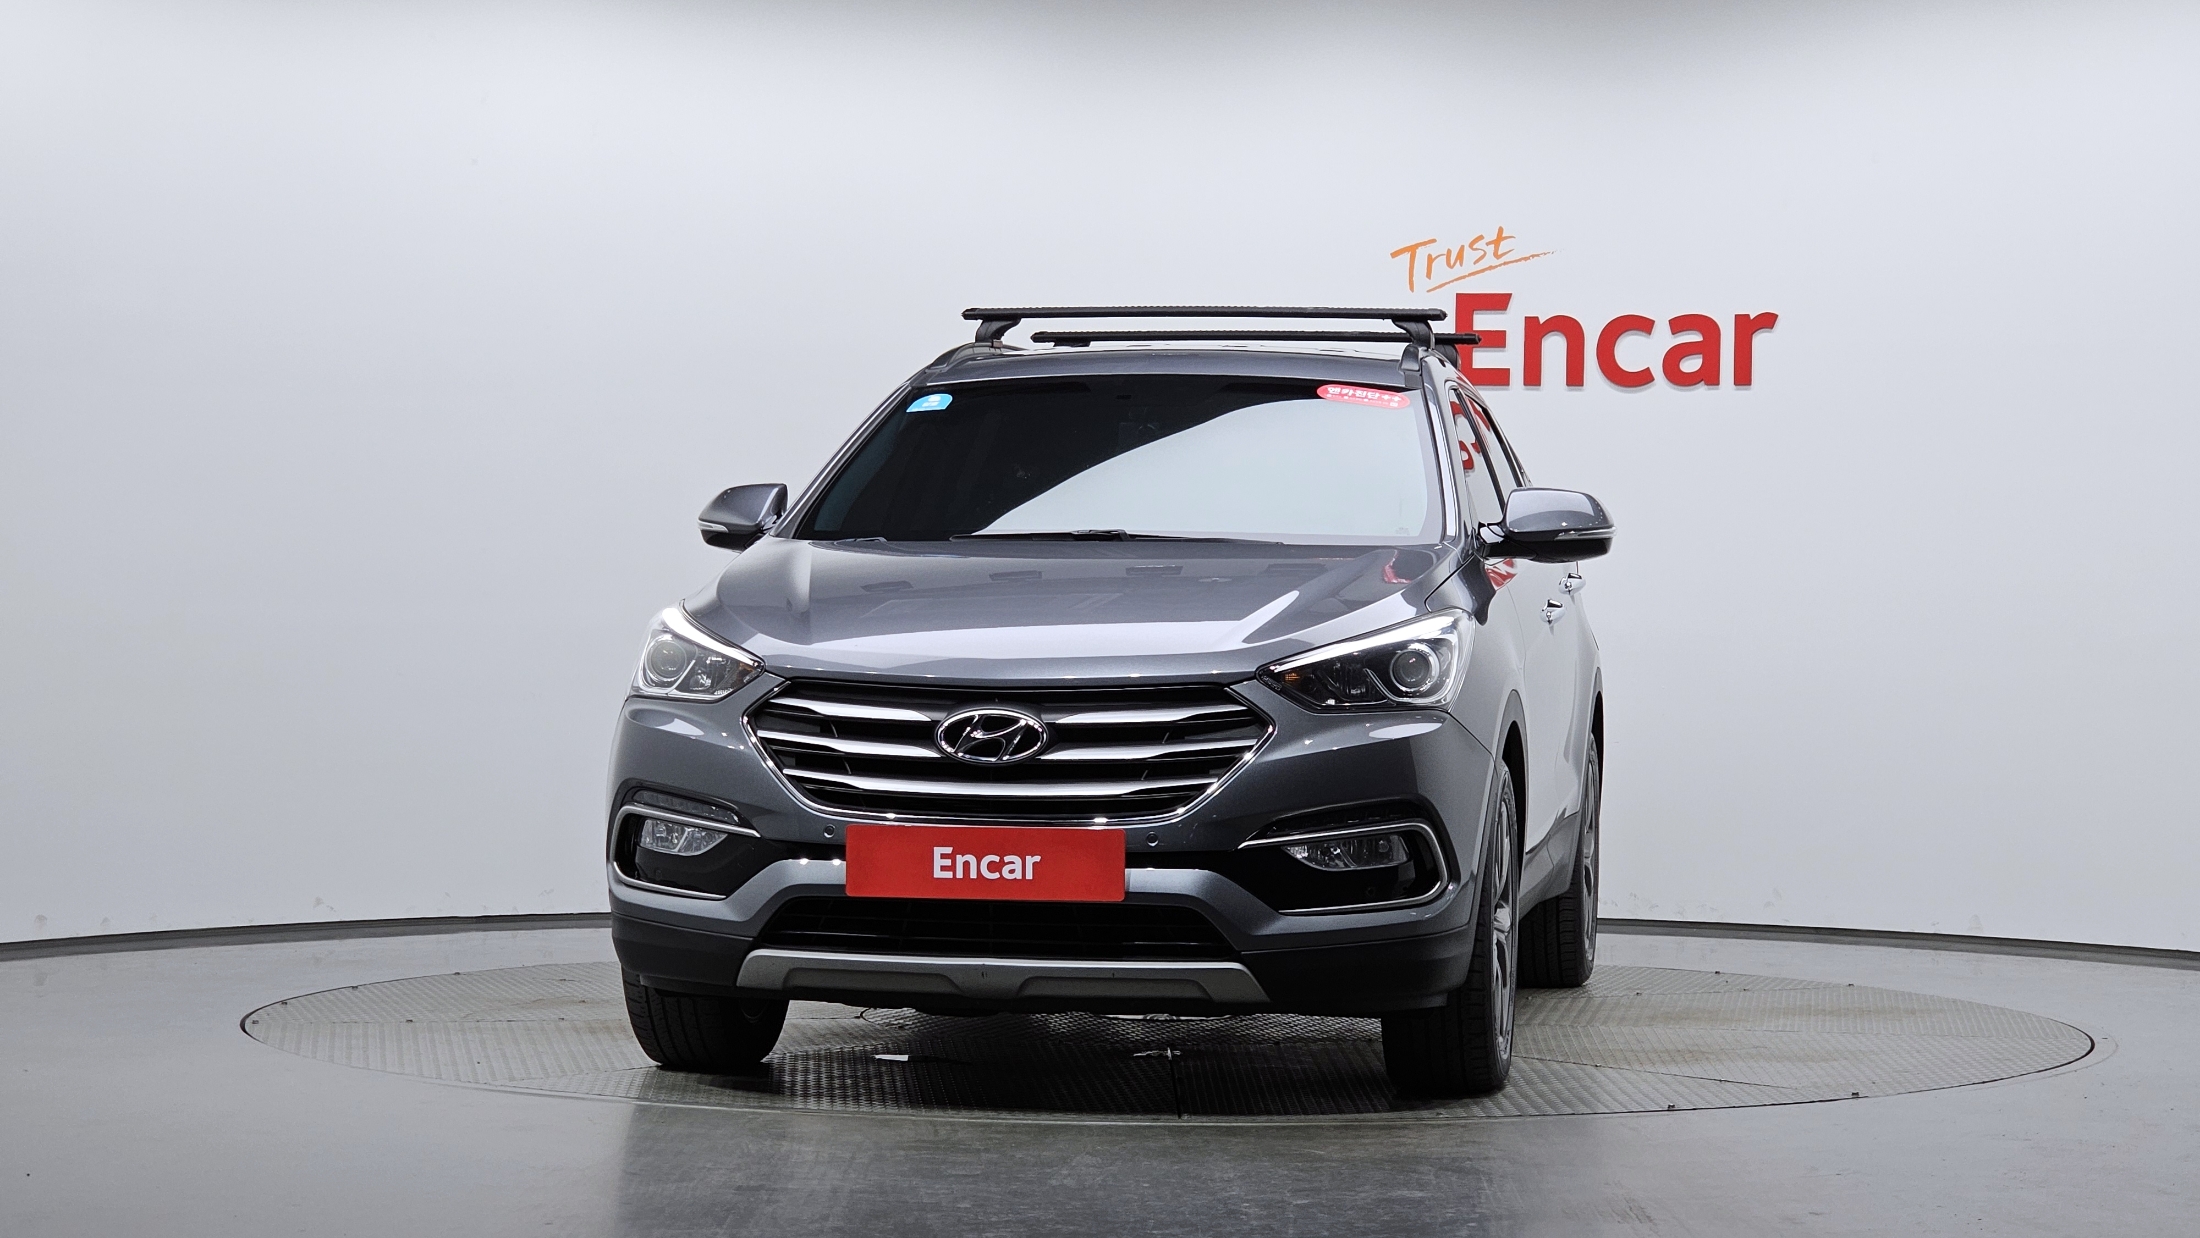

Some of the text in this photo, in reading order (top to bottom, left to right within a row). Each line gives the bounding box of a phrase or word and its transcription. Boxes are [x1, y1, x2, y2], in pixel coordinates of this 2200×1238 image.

[1390, 226, 1516, 293] Trust
[1455, 292, 1779, 388] Encar
[933, 846, 1041, 880] Encar
